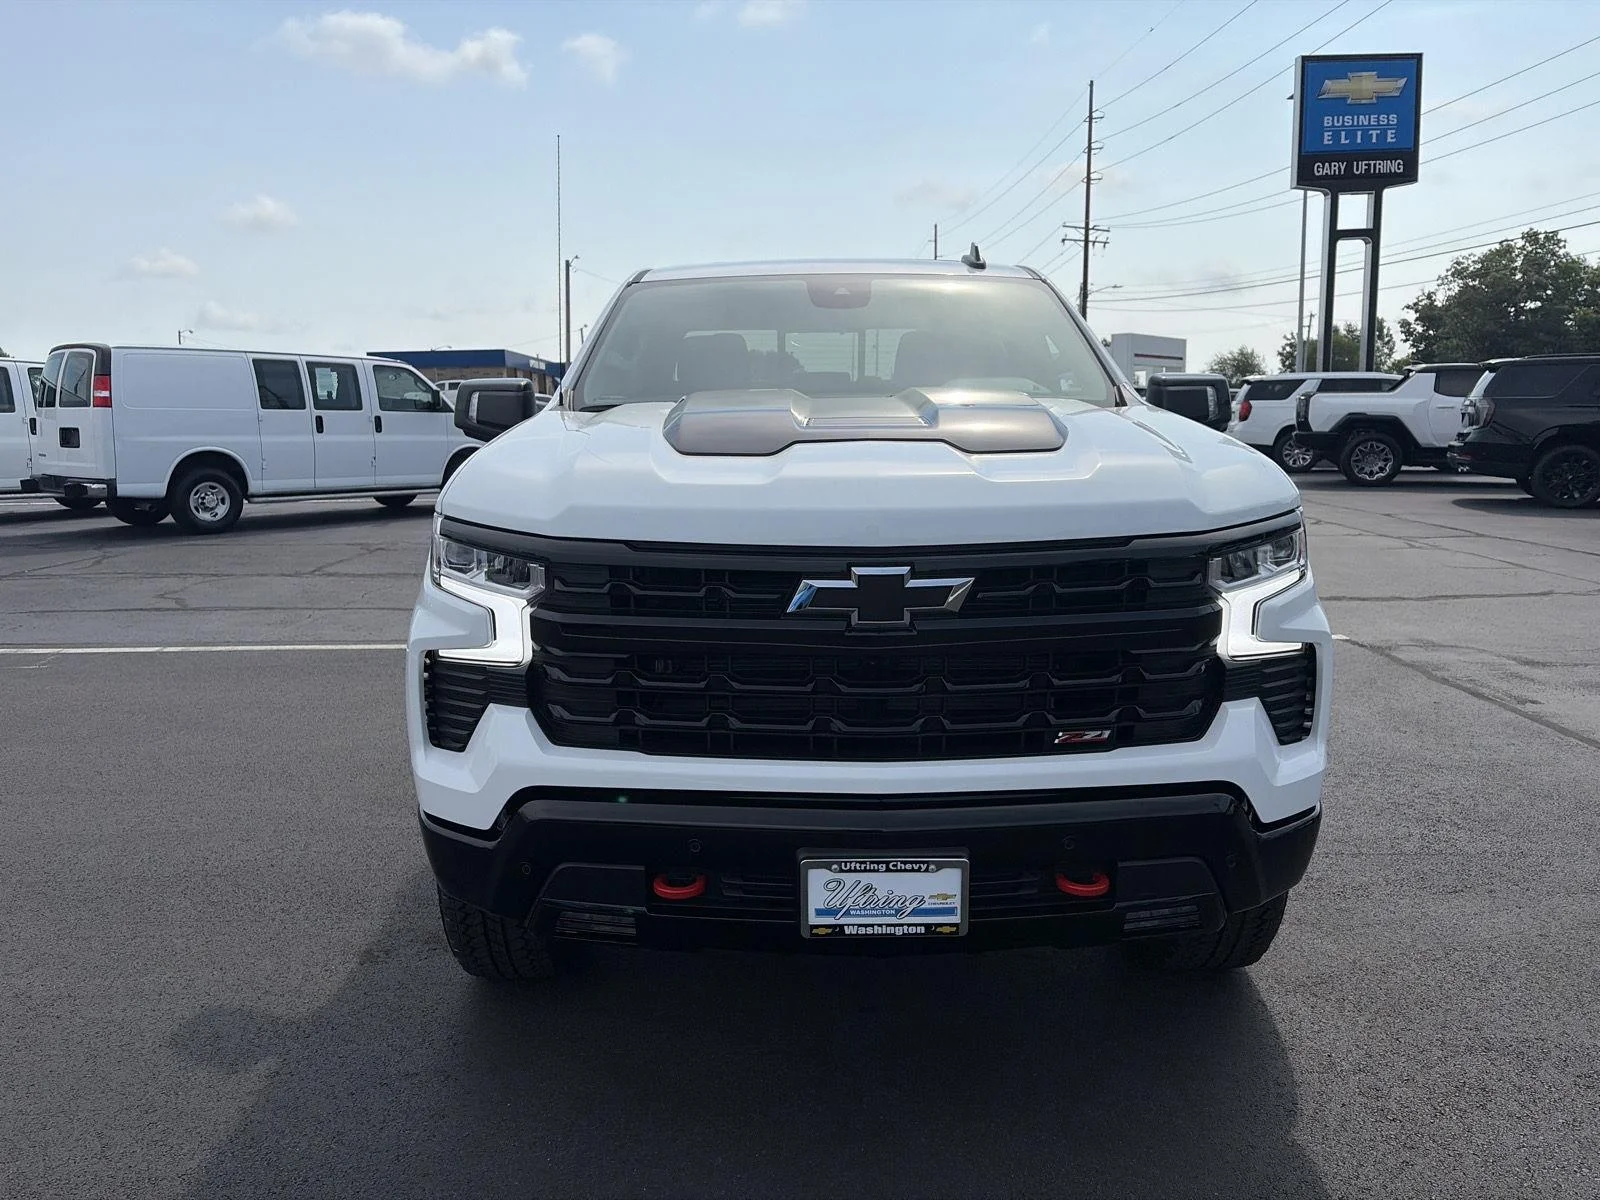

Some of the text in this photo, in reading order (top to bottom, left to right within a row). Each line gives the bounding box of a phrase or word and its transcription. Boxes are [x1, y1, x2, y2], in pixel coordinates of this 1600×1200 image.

[1323, 114, 1397, 127] BUSINESS
[1323, 129, 1397, 144] ELITE
[1314, 160, 1404, 176] GARY UFTRING
[841, 862, 928, 872] Uftring Chevy
[823, 878, 926, 920] Uftring
[844, 925, 925, 936] Washington
